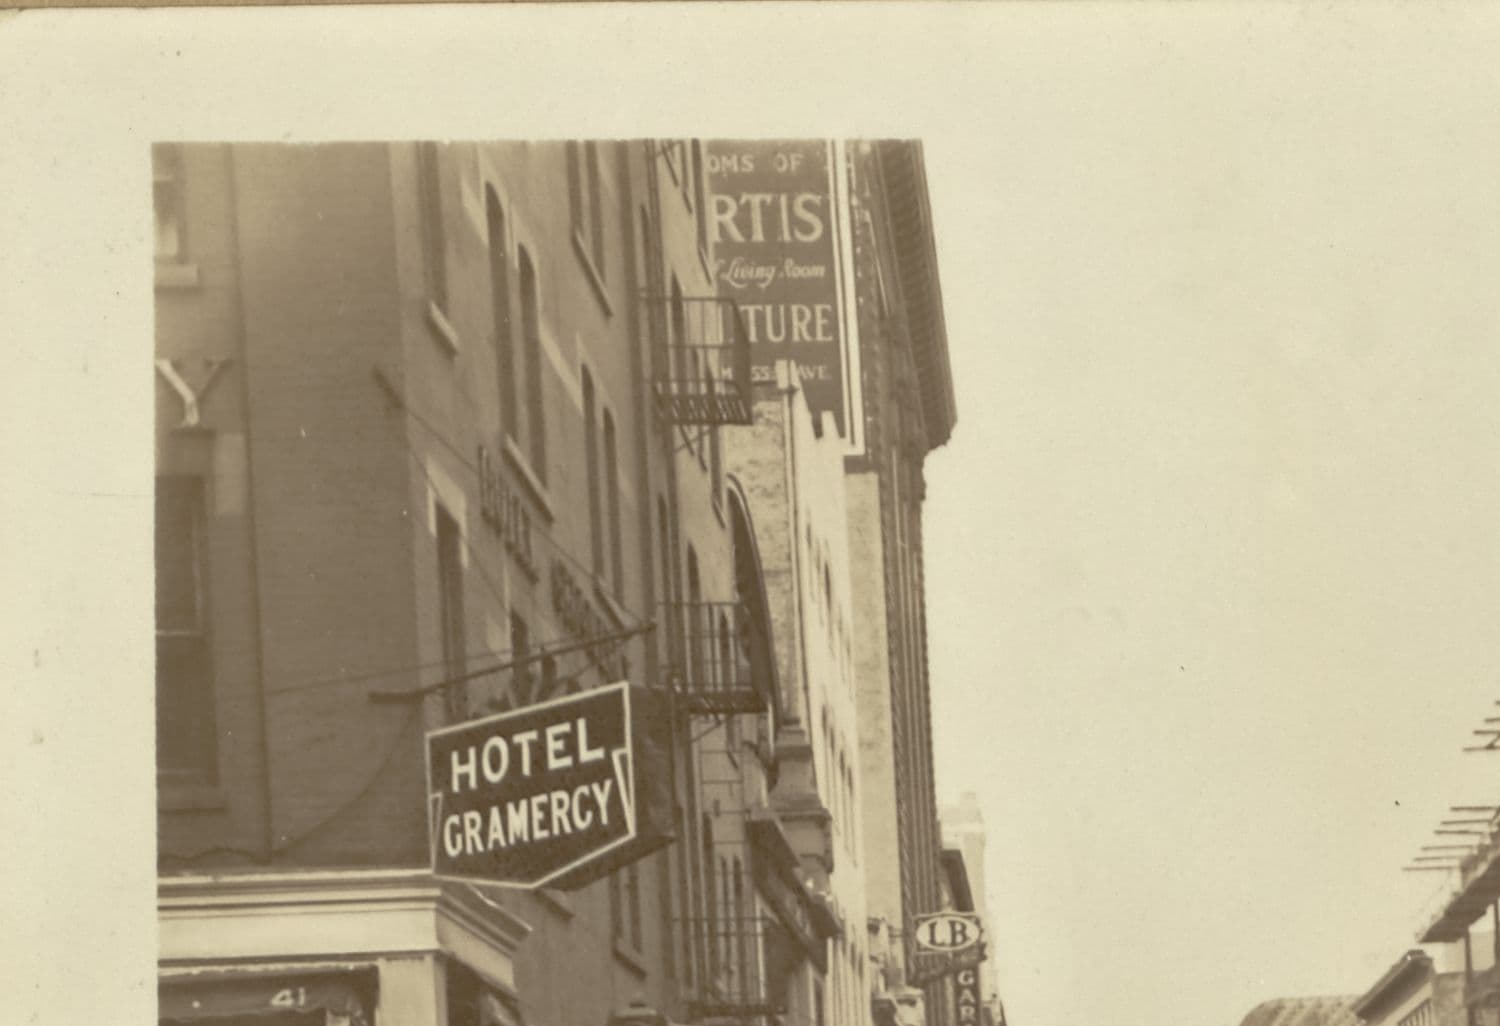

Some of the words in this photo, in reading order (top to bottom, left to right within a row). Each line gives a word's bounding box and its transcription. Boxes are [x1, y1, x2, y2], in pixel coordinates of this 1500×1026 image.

[775, 152, 805, 174] OF
[712, 192, 824, 243] RTIS
[720, 257, 776, 289] Living
[781, 258, 826, 280] Room
[451, 717, 606, 793] HOTEL
[443, 778, 613, 857] GRAMERCY
[270, 987, 306, 1008] 41
